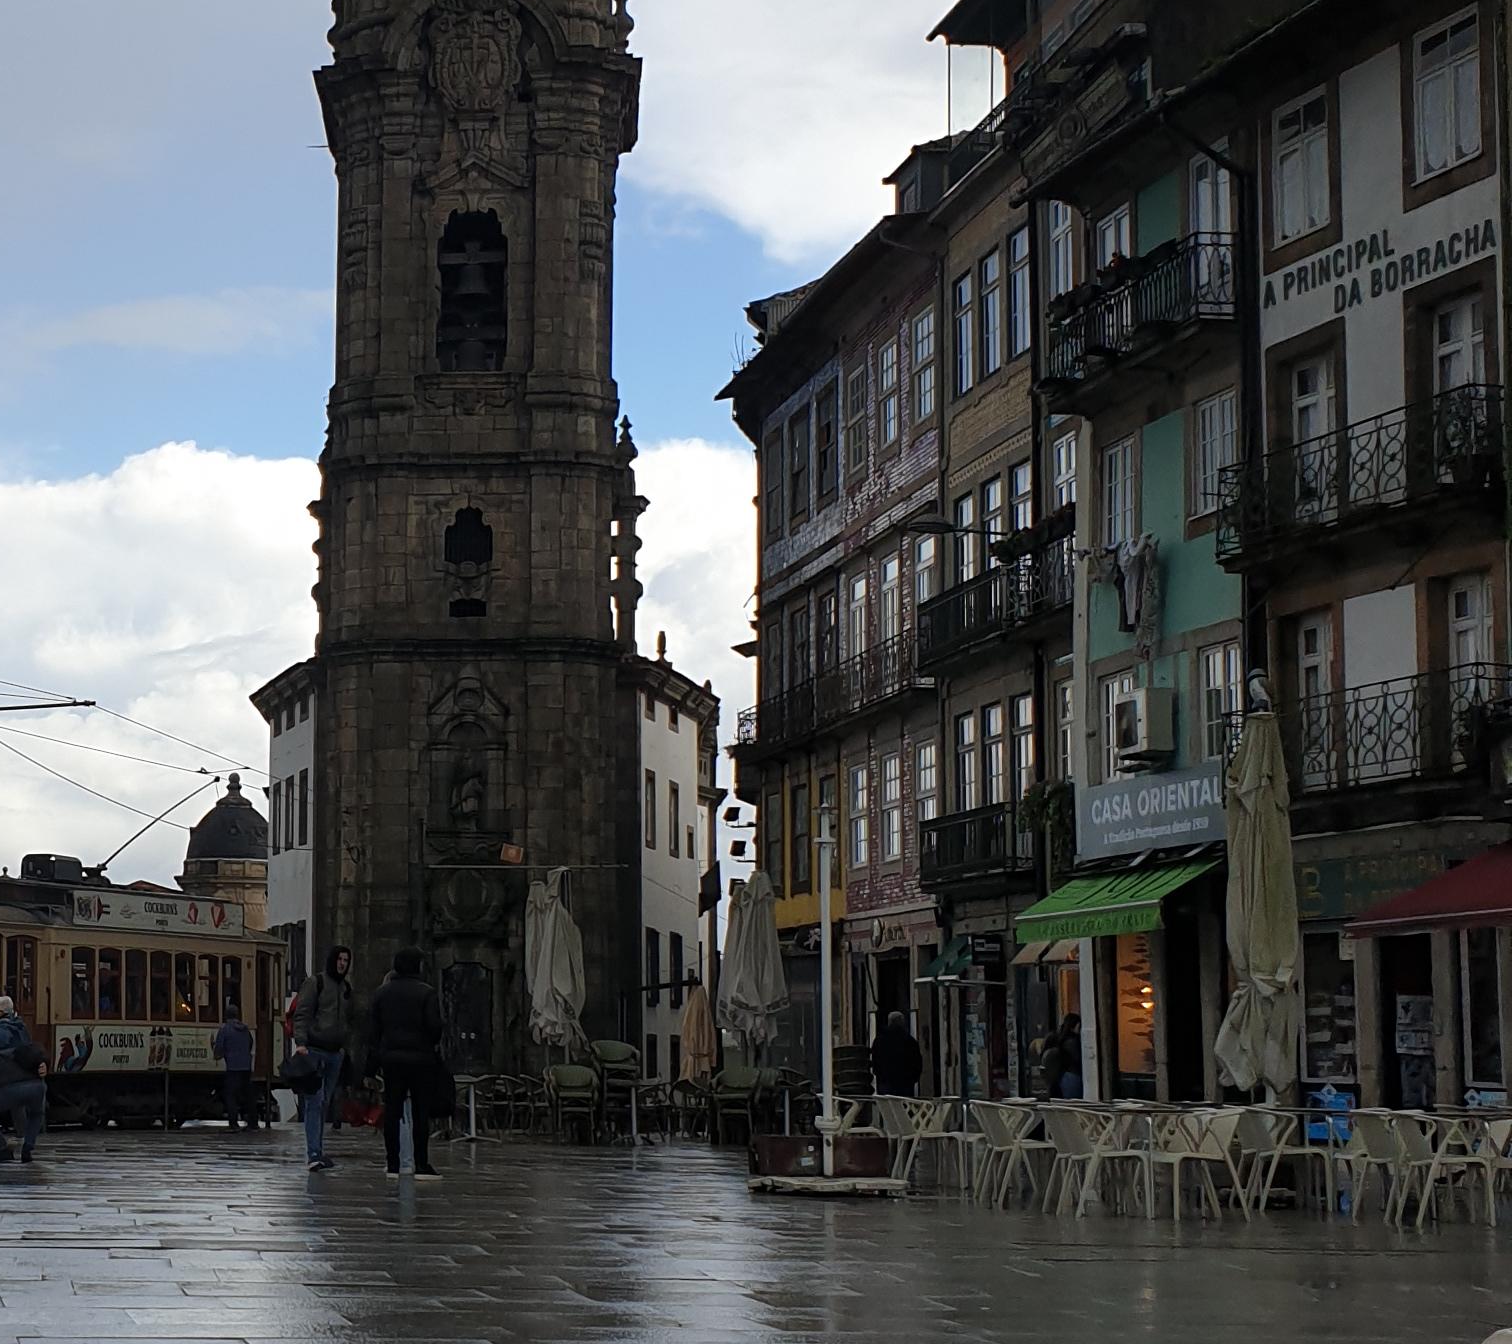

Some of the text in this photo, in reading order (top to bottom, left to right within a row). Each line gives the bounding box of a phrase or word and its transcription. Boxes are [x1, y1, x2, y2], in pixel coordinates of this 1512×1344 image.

[1264, 229, 1395, 309] A PRINCIPAL
[1334, 218, 1497, 314] DA BORRACHA
[1091, 775, 1224, 825] CASA ORIENTAL
[98, 1031, 144, 1048] COCKBURN'S
